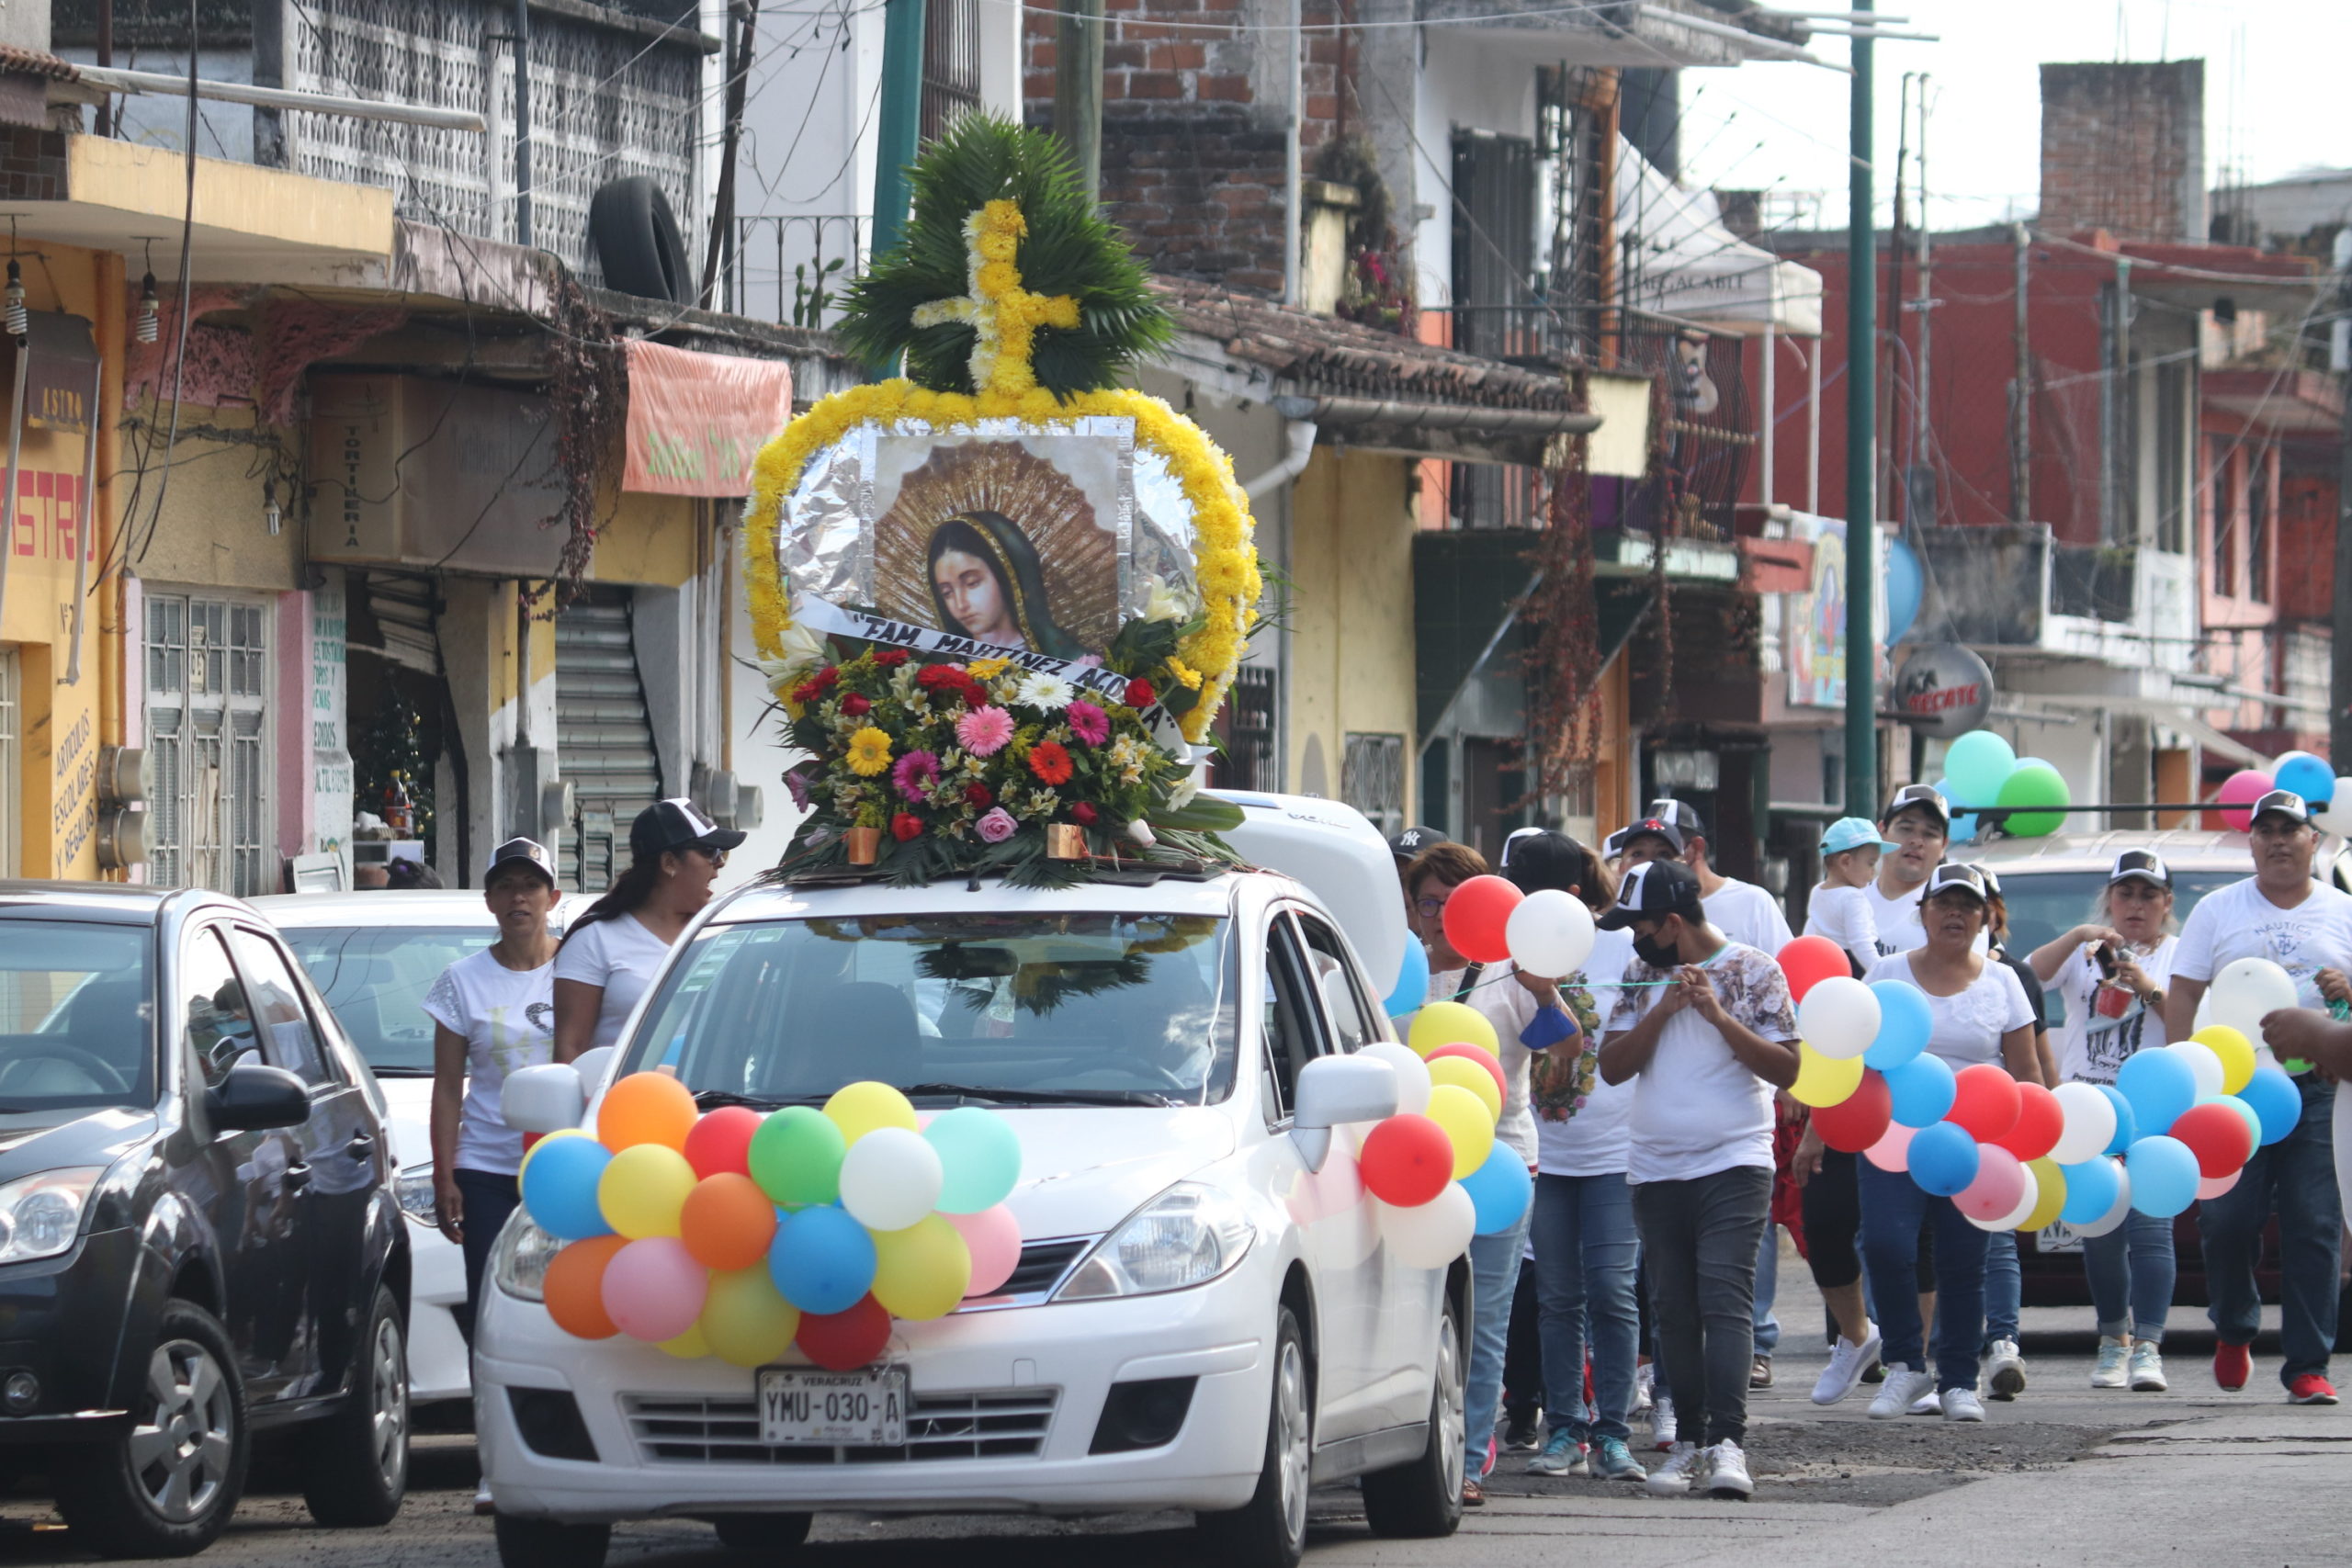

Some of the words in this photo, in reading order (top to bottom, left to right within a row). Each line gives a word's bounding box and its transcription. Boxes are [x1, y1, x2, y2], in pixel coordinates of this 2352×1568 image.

[933, 635, 1072, 676] MARTINEZ
[1907, 682, 1981, 715] TECATE
[56, 707, 91, 779] ARTICULOS
[54, 750, 96, 835] ESCOLARES
[64, 797, 96, 868] REGALOS
[802, 1377, 863, 1387] VERACRUZ
[765, 1391, 899, 1423] YMU-030-A
